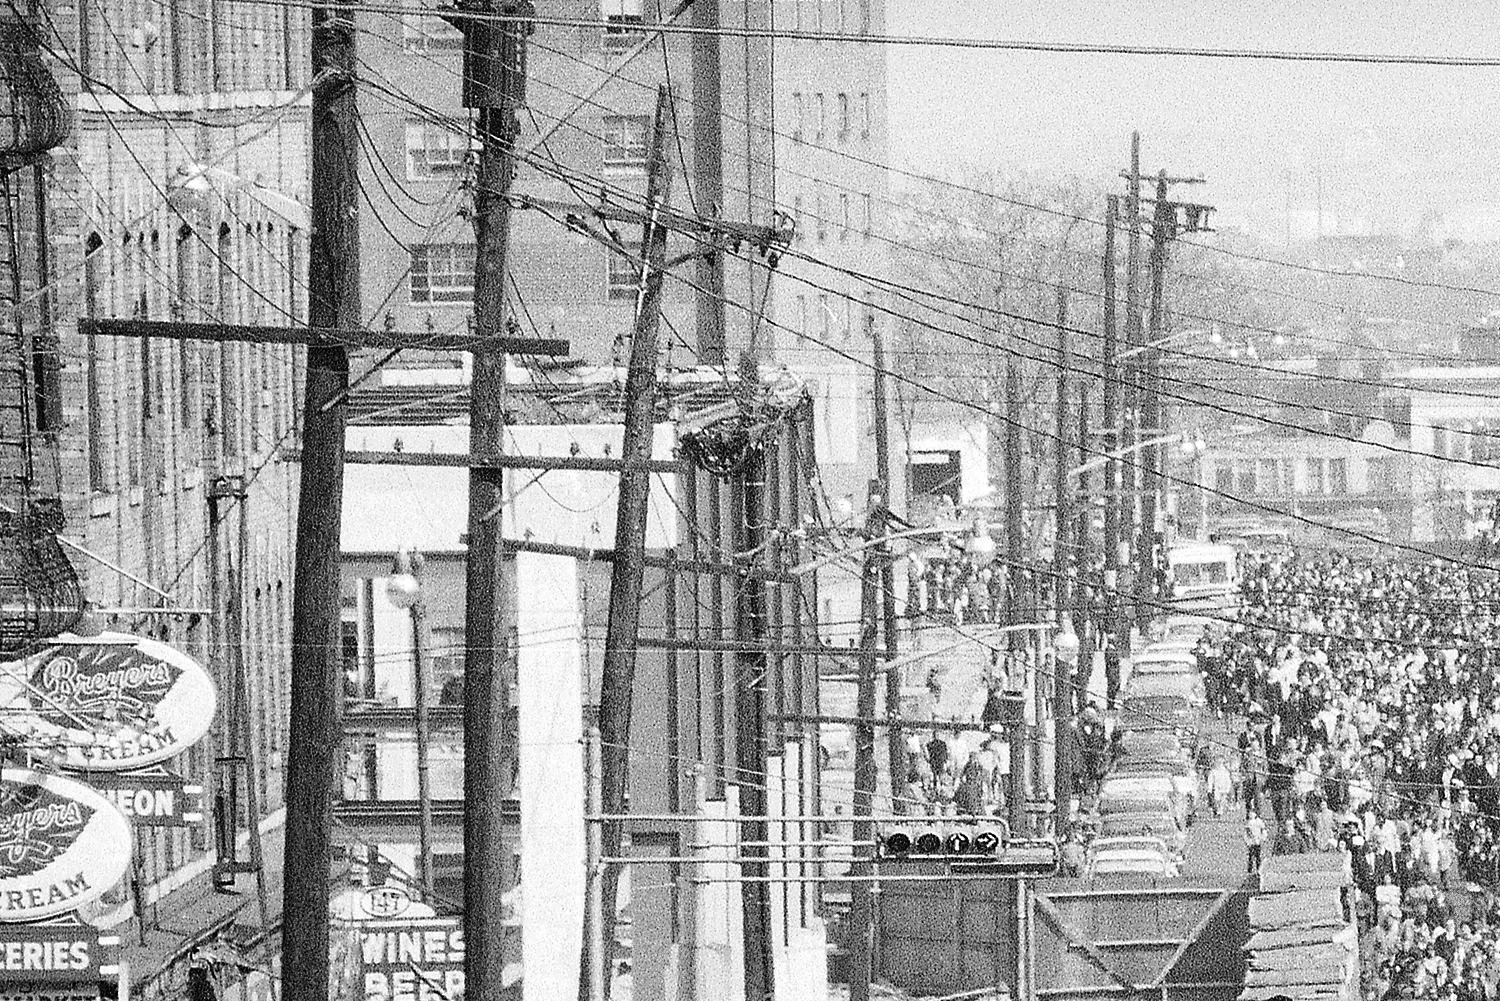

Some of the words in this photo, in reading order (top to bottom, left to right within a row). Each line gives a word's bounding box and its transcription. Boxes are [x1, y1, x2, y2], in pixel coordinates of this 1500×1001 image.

[44, 656, 171, 712] Breyers
[0, 801, 82, 856] eyers
[0, 872, 91, 911] REAM
[0, 941, 90, 971] ERIES
[360, 930, 465, 964] WINES
